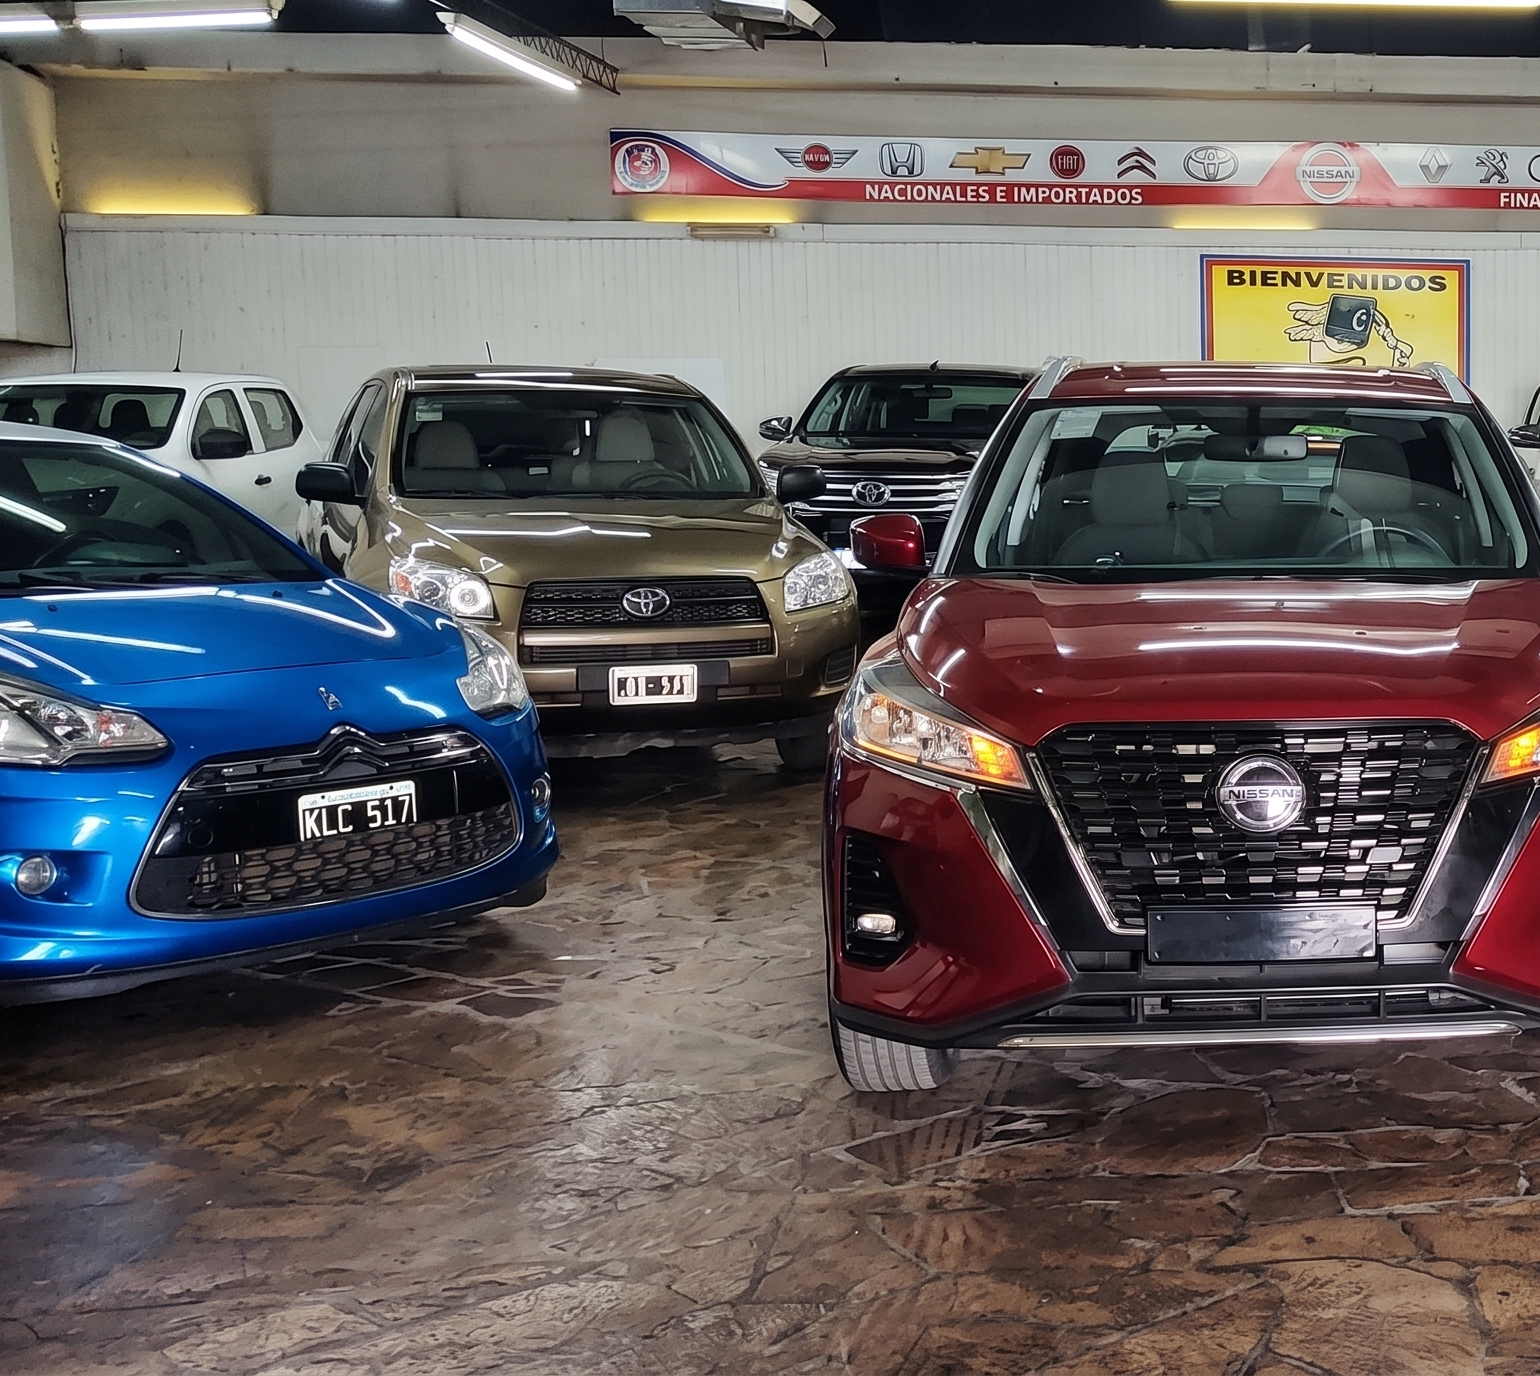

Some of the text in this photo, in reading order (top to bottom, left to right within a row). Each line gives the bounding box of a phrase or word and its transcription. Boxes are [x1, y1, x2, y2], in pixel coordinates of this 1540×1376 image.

[1057, 155, 1079, 170] FIAT
[1302, 169, 1355, 179] NISSAN
[865, 184, 1143, 204] NACIONALES E IMPORTADOS
[1226, 269, 1448, 292] BIENVENIDOS
[1228, 789, 1294, 800] NISSAN
[304, 804, 354, 839] KLC
[366, 795, 410, 828] 517
